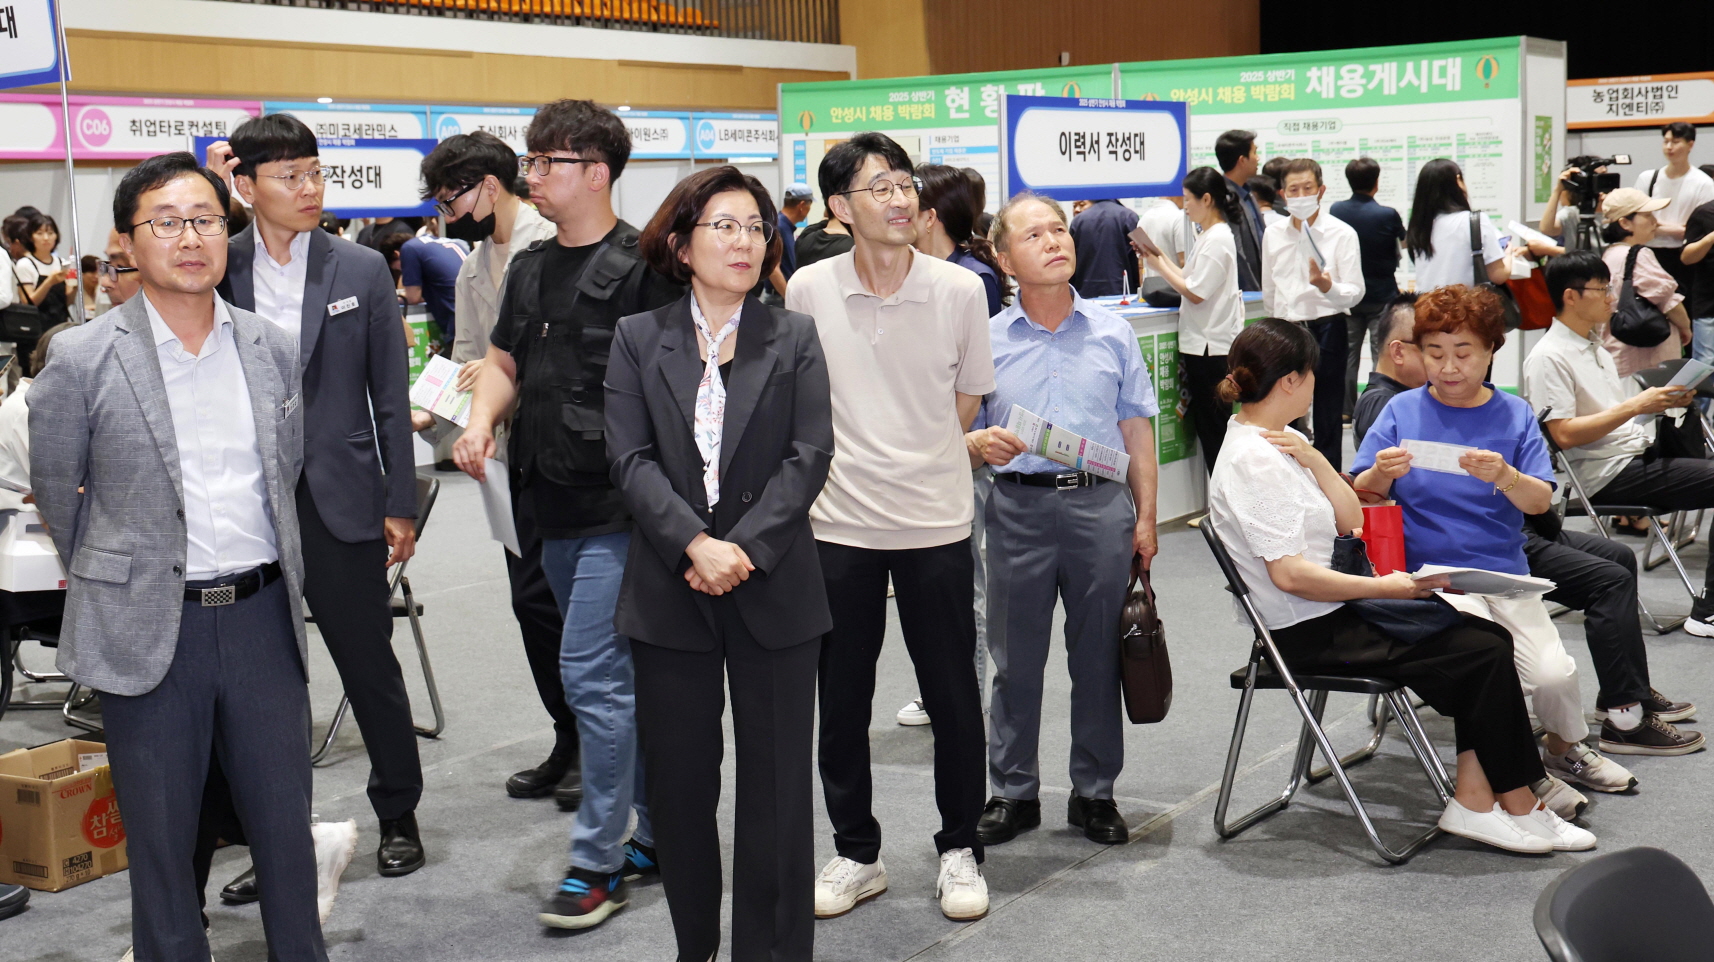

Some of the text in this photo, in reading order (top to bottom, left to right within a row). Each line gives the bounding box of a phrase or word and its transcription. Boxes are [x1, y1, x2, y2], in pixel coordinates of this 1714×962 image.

[1240, 69, 1295, 82] 2025 상반기
[1305, 57, 1461, 99] 채용게시대
[888, 91, 935, 102] 2025 상반기
[1170, 83, 1295, 106] 안성시 채용 박람회
[1592, 84, 1679, 103] 농업회사법인
[829, 103, 935, 123] 안성시 채용 박람회
[83, 119, 109, 135] C06
[129, 119, 227, 137] 취업타로컨설팅
[1284, 120, 1336, 132] 직접 채용기업
[1059, 131, 1145, 162] 이력서 작성대
[330, 164, 382, 190] 작성대
[1159, 351, 1174, 365] 안성시
[60, 784, 92, 799] CROWN
